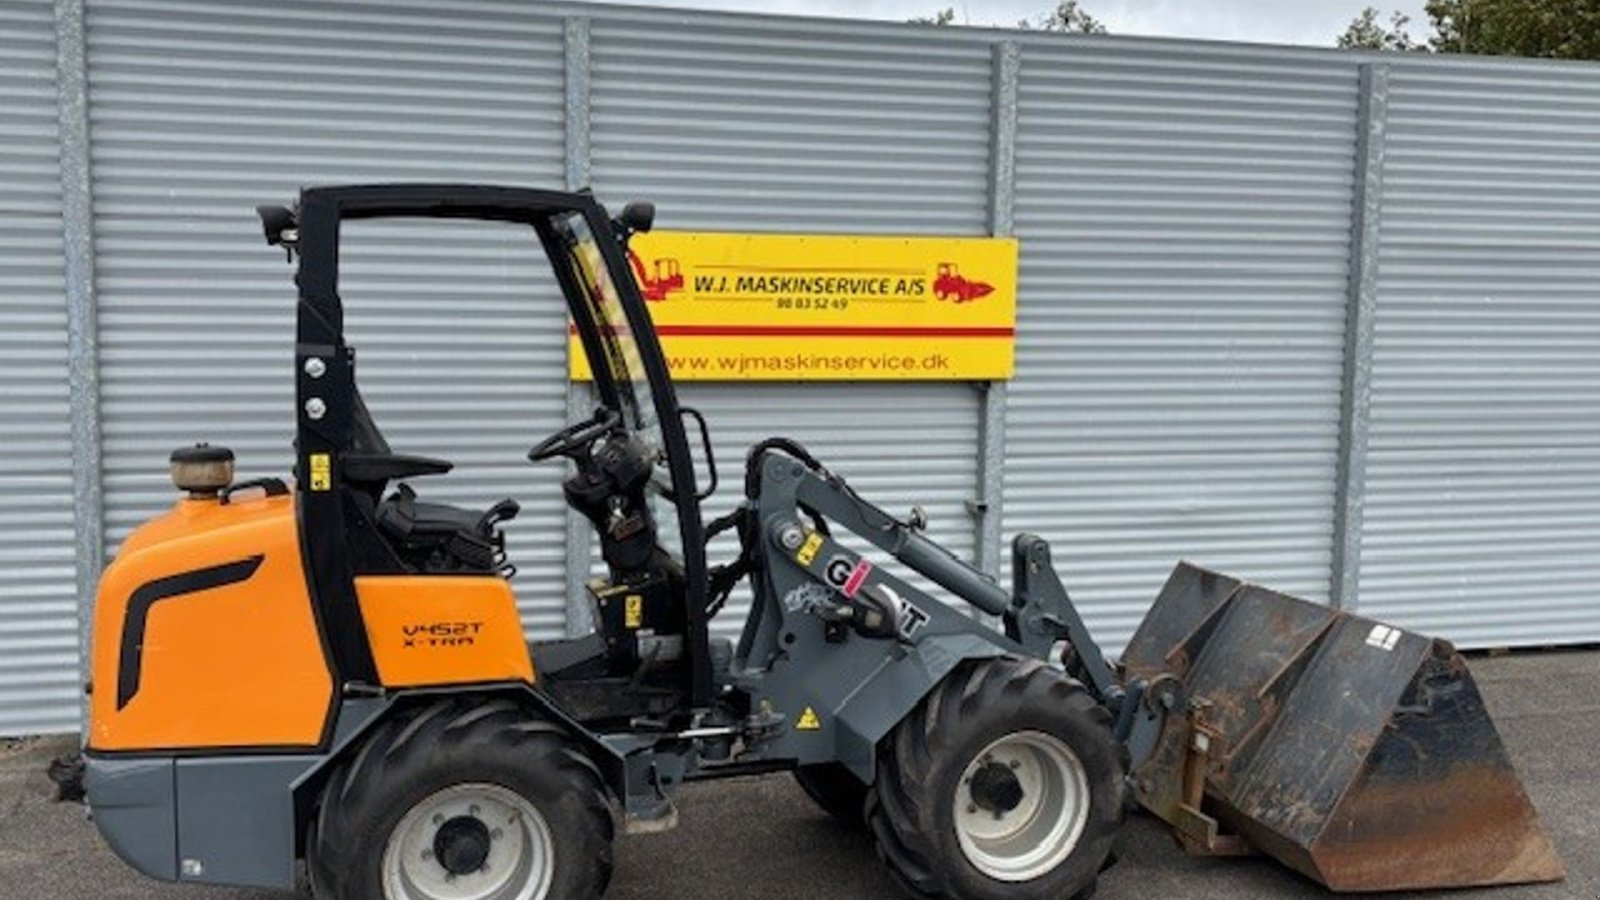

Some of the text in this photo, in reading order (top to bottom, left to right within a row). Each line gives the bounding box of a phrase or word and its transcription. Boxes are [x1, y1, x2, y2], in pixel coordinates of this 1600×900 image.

[695, 276, 926, 296] W.J. MASKINSERVICE A/S
[664, 352, 950, 374] ww.wjmaskinservice.dk
[402, 622, 484, 636] V452T
